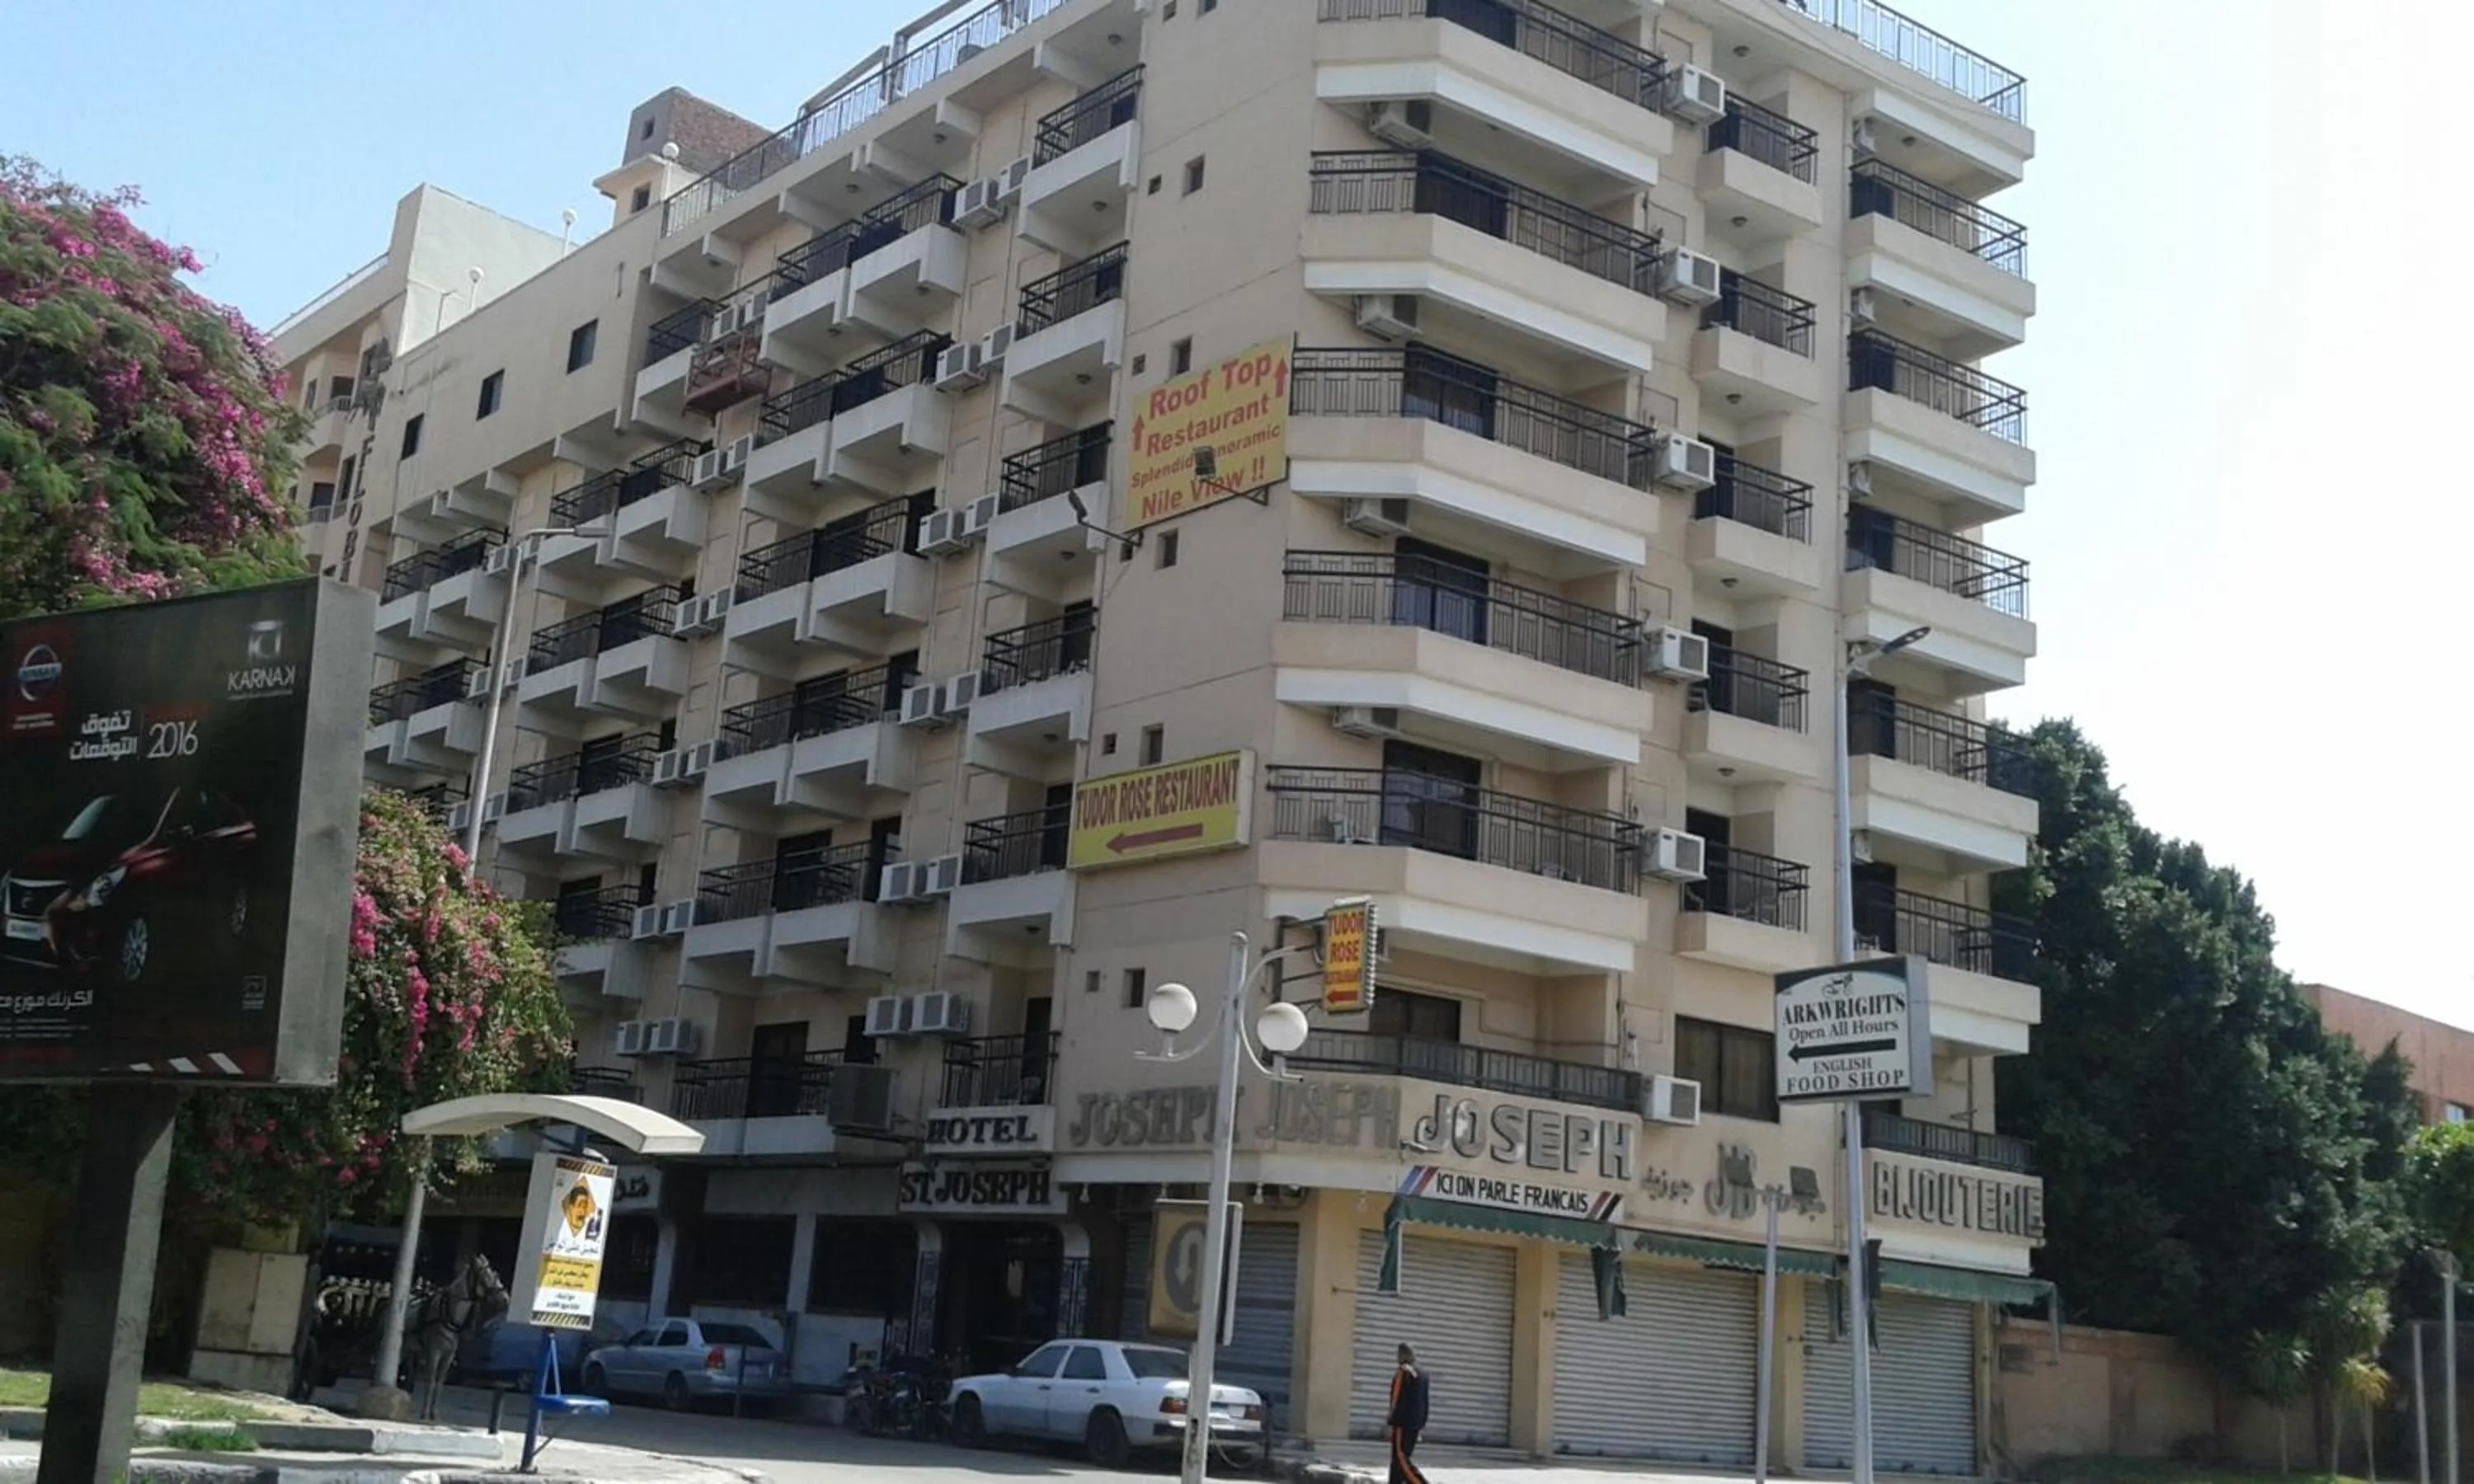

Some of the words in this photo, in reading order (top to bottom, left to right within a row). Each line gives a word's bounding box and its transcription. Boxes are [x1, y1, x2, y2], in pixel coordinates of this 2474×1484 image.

[1150, 370, 1212, 420] Roof
[1221, 353, 1272, 392] Top
[1147, 392, 1271, 458] Restaurant
[1214, 424, 1281, 457] noramic
[1141, 489, 1183, 519] Nile
[1190, 468, 1244, 501] View
[81, 710, 132, 738] تفوق
[146, 719, 199, 759] 2016
[69, 735, 139, 762] التوقعات
[1075, 784, 1116, 831] TUDOR
[1119, 776, 1153, 824] ROSE
[1155, 758, 1240, 818] RESTAURANT
[1329, 911, 1364, 937] TUDOR
[1330, 941, 1360, 963] ROSE
[1781, 993, 1906, 1026] ARKWRIGHTS
[1789, 1026, 1826, 1044] Open
[1830, 1021, 1848, 1037] All
[1853, 1019, 1899, 1036] Hours
[1787, 1075, 1840, 1093] FOOD
[1848, 1069, 1903, 1088] SHOP
[1813, 1057, 1872, 1073] ENGLISH
[927, 1115, 1038, 1144] HOTEL
[1414, 1094, 1634, 1181] JOSEPH
[935, 1169, 1051, 1205] JOSEPH
[1437, 1172, 1453, 1194] ICI
[1456, 1176, 1475, 1198] ON
[1479, 1178, 1520, 1205] PARLE
[1873, 1161, 2045, 1239] BIJOUTERIE
